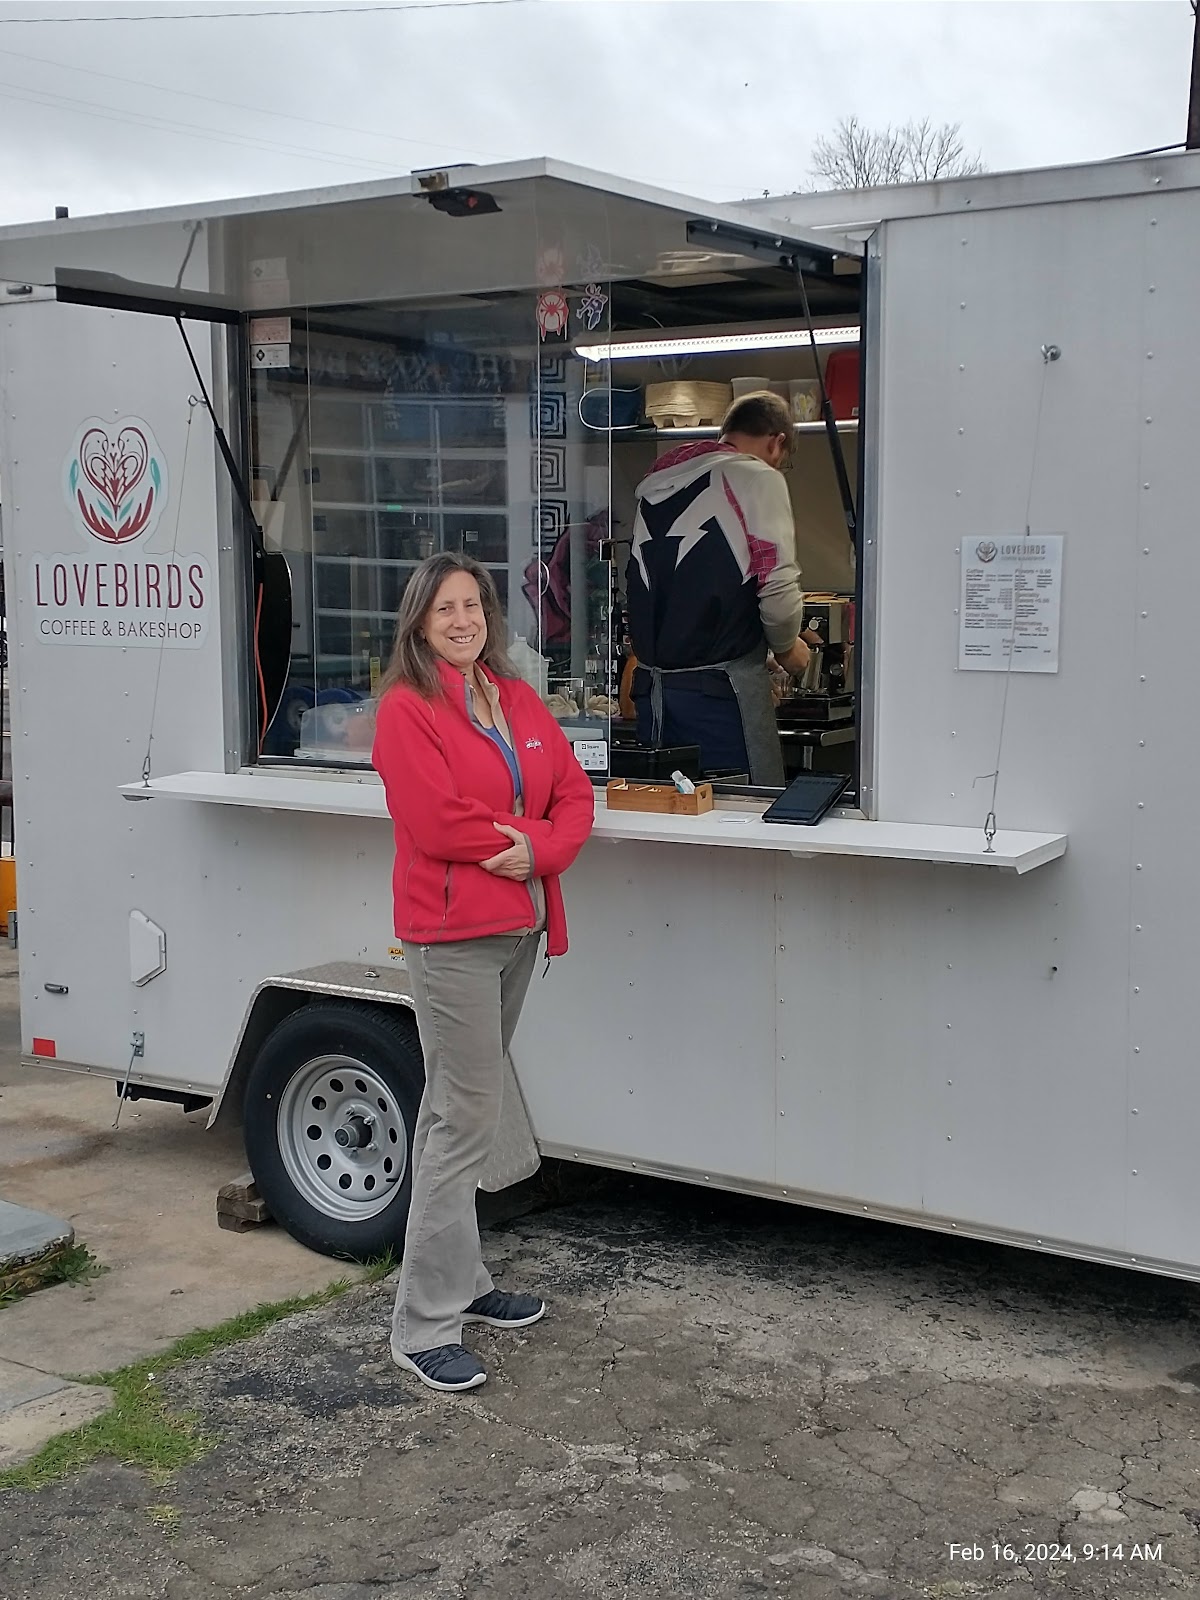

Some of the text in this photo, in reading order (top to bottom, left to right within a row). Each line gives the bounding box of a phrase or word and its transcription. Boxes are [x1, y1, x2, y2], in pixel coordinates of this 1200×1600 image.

[35, 563, 204, 609] LOVEBIRDS
[40, 619, 202, 639] COFFEE & BAKESHOP
